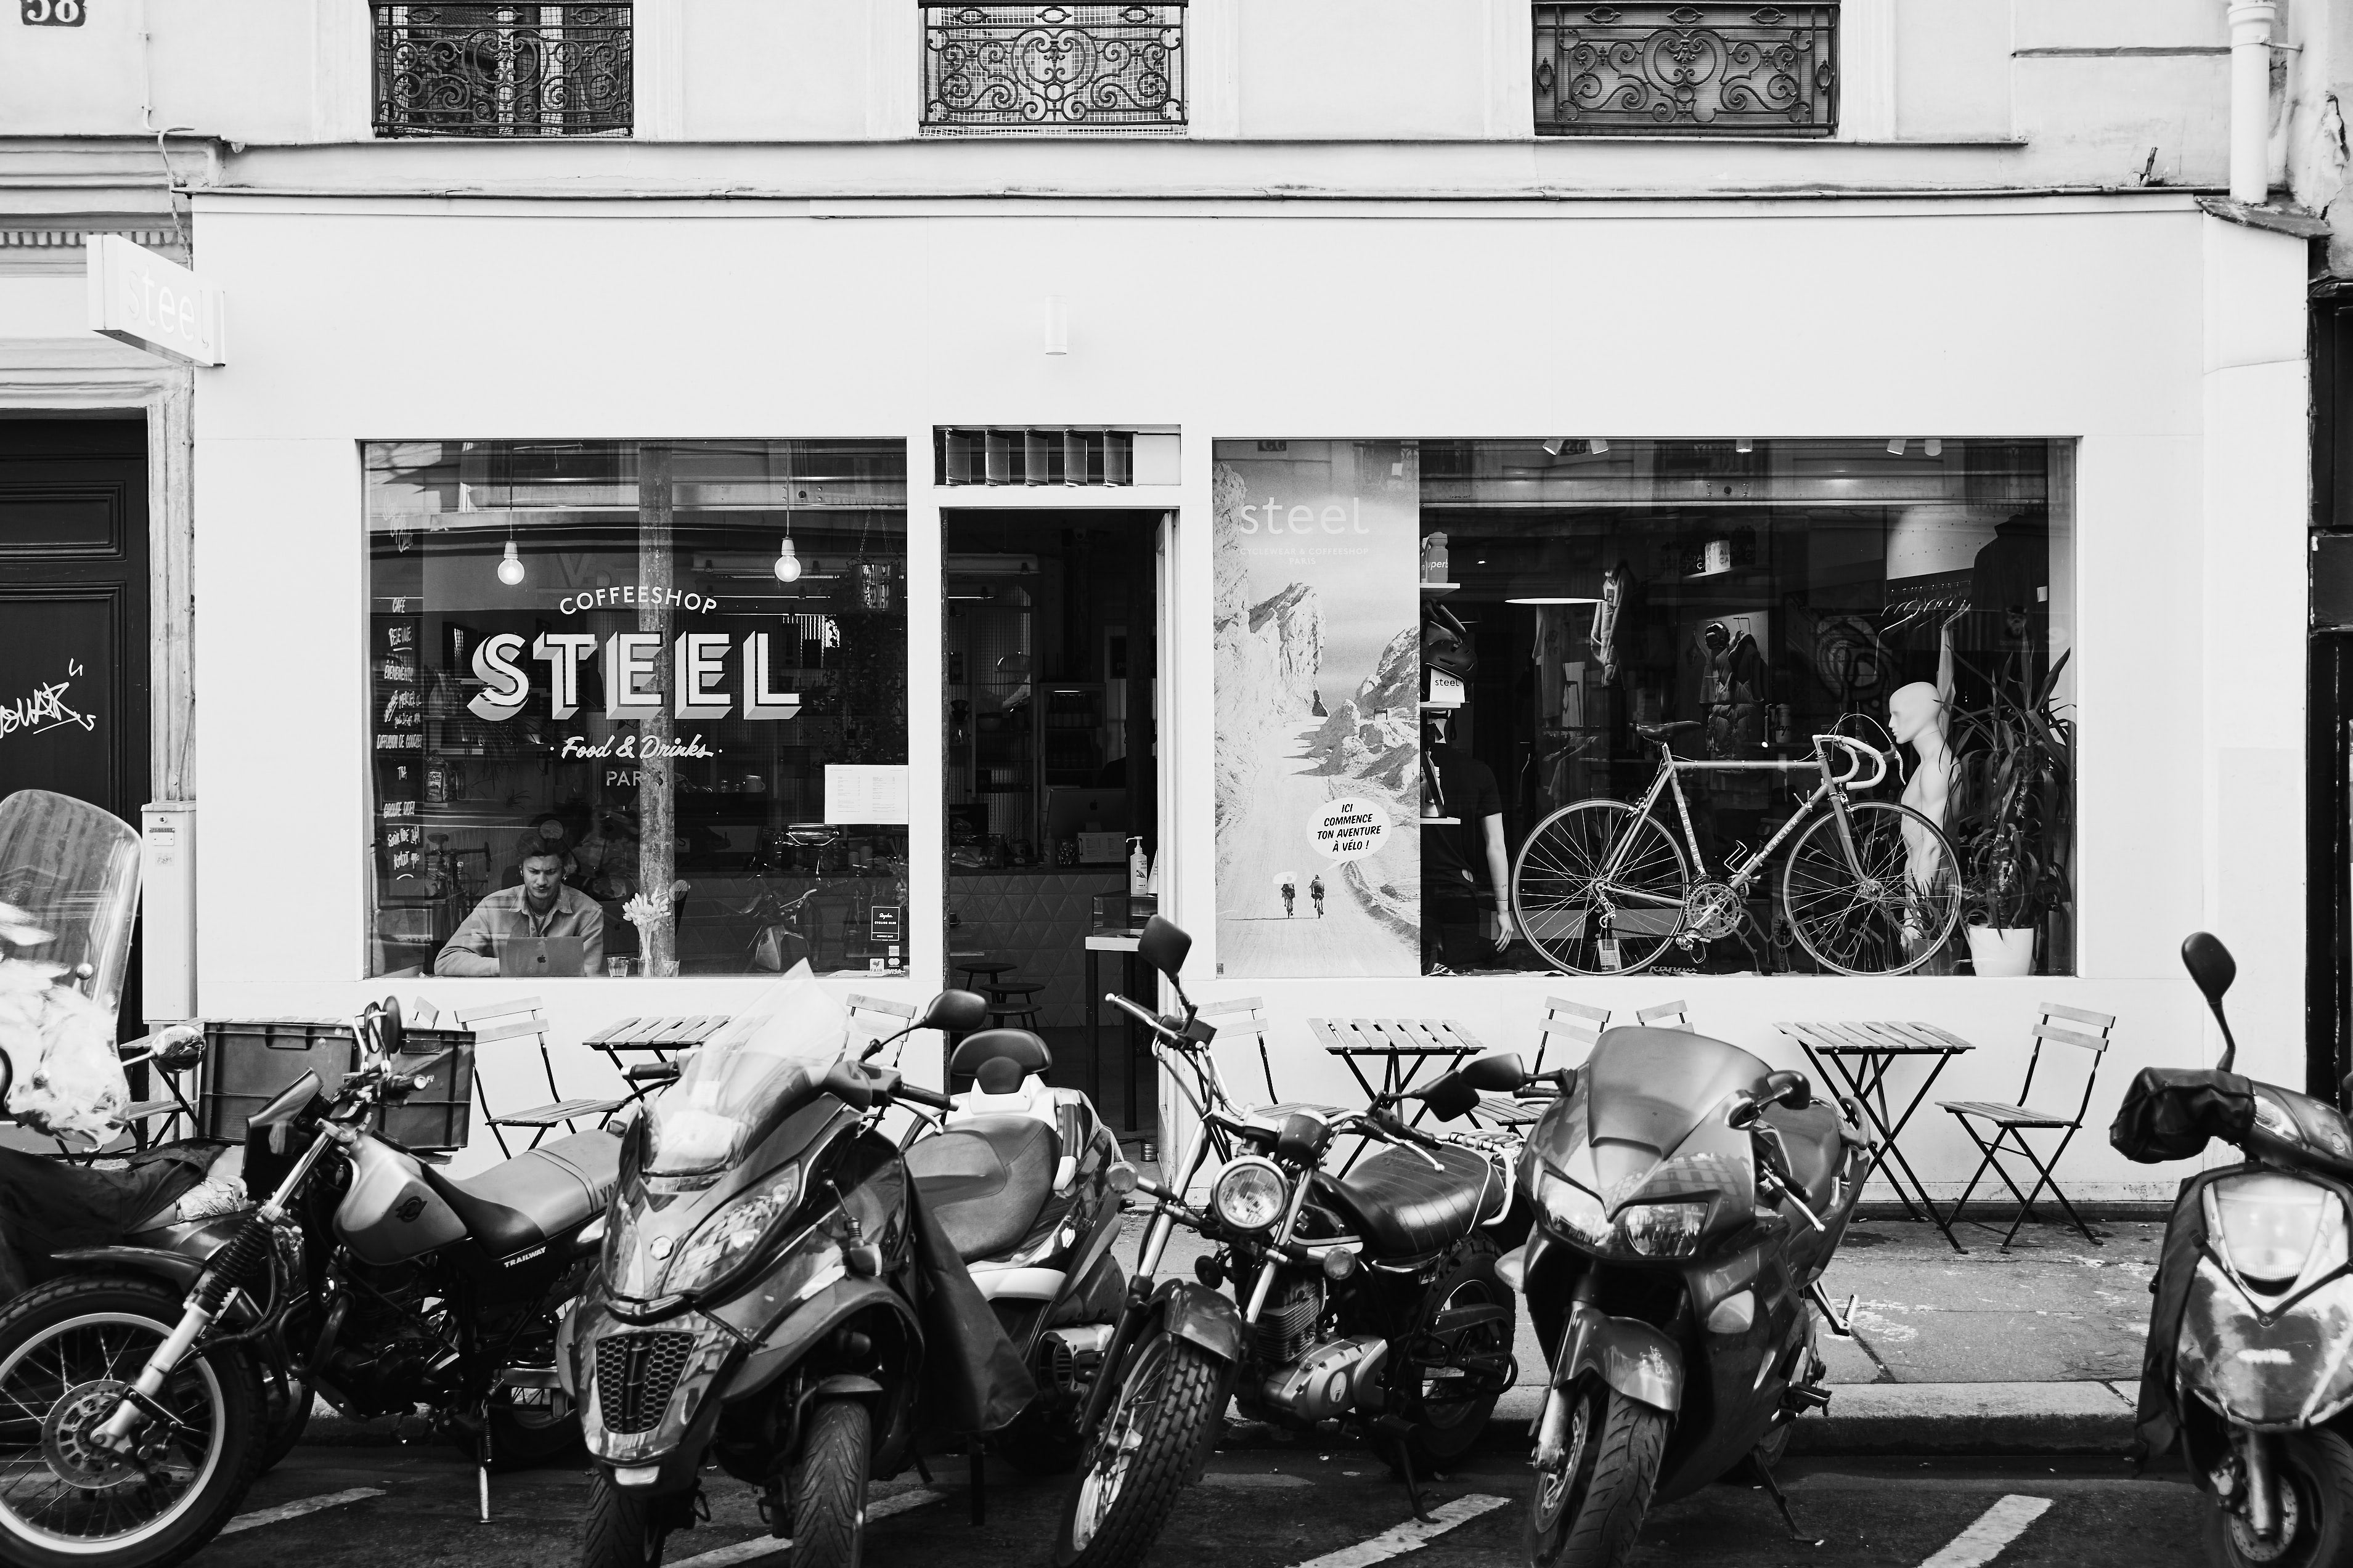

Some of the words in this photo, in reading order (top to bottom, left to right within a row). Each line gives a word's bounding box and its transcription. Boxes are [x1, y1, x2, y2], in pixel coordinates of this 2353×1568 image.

[128, 264, 210, 349] steel
[1239, 497, 1369, 535] steel
[560, 586, 718, 615] COFFEESHOP
[467, 630, 803, 721] STEEL
[1435, 678, 1459, 687] steel
[561, 734, 616, 759] Food
[616, 735, 636, 758] &
[639, 733, 714, 760] Drinks
[606, 771, 664, 787] PARS
[1324, 813, 1373, 827] COMMENCE
[1341, 803, 1353, 813] ICI
[1317, 830, 1334, 840] TON
[1336, 825, 1382, 839] AVENTURE
[1677, 802, 1701, 861] MERCIER
[1760, 818, 1799, 859] MERCIER
[1332, 840, 1339, 852] À
[1342, 839, 1363, 851] VÉLO
[504, 1246, 547, 1269] TRAILWAY
